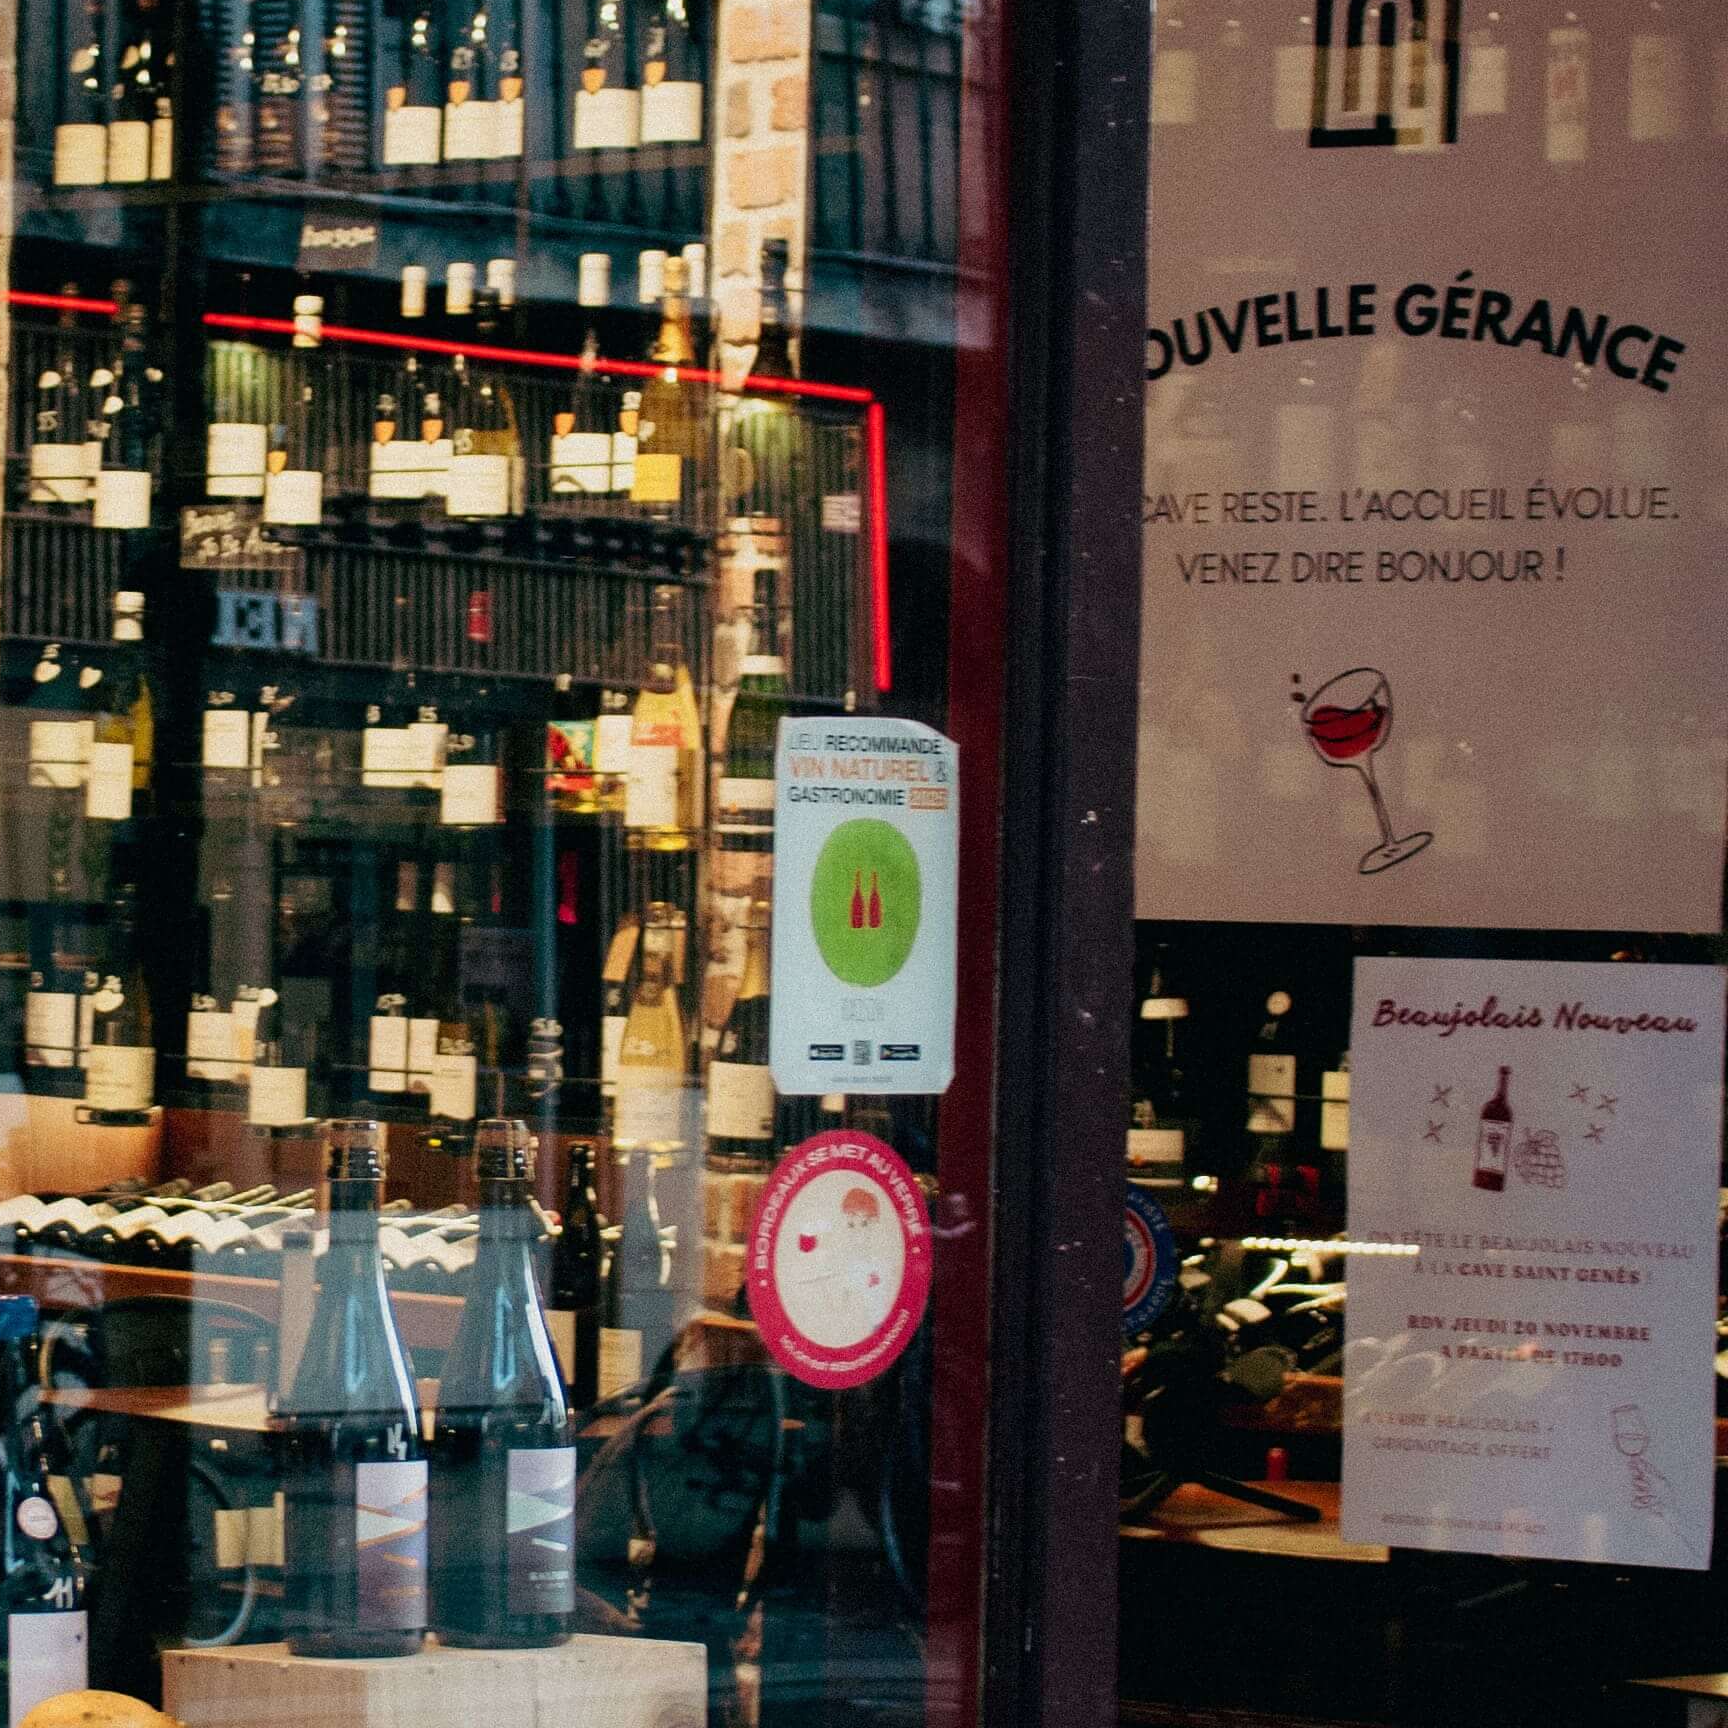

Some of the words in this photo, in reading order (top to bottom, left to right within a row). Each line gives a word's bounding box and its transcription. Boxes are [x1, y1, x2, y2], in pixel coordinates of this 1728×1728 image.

[1393, 268, 1687, 394] GÉRANCE
[1221, 489, 1329, 525] RESTE.
[1339, 486, 1516, 523] L'ACCUEIL
[1525, 478, 1681, 521] ÉVOLUE.
[1175, 550, 1281, 586] VENEZ
[1290, 549, 1365, 584] DIRE
[1376, 547, 1545, 583] BONJOUR
[1554, 545, 1565, 582] !
[789, 756, 825, 779] VIN
[831, 757, 930, 783] NATUREL
[787, 784, 906, 807] GASTRONOMIE
[1371, 994, 1545, 1040] Beaujolais
[1552, 999, 1699, 1036] Nouveau
[755, 1161, 808, 1271] BORDEAUX
[807, 1145, 831, 1166] SE
[830, 1142, 872, 1161] MET
[867, 1152, 895, 1176] AU
[888, 1169, 925, 1235] VERRE
[1457, 1260, 1506, 1280] CAVE
[1510, 1263, 1571, 1283] SAINT
[1543, 1320, 1653, 1345] NOVEMBRE
